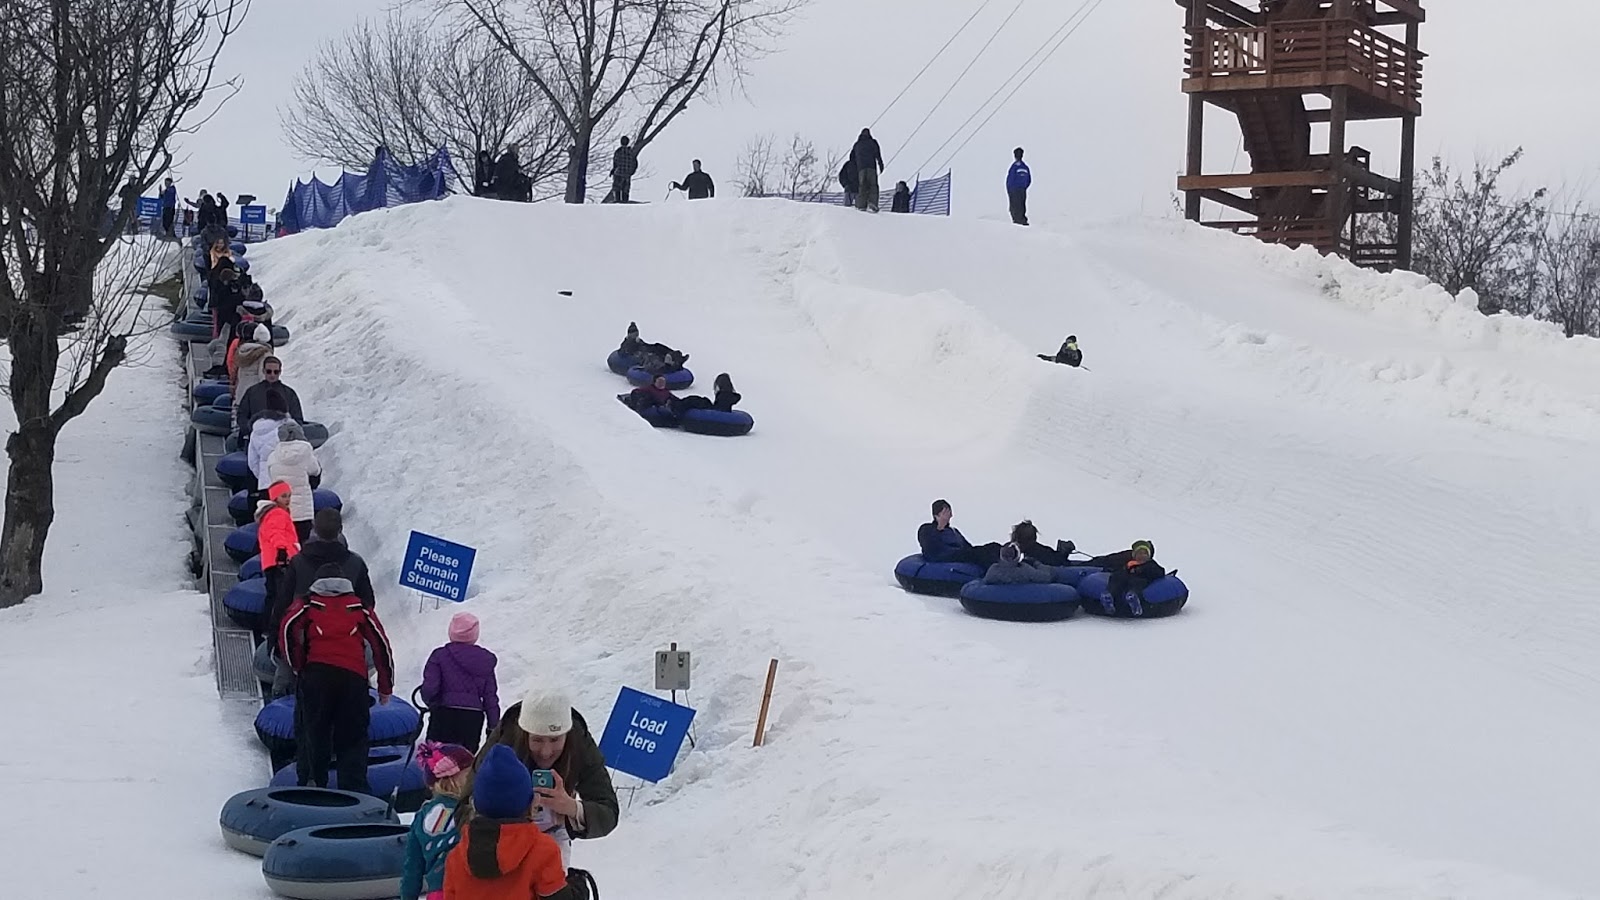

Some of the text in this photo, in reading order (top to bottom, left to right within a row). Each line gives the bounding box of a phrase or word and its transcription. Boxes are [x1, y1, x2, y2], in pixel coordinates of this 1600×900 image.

[420, 546, 459, 568] Please
[414, 559, 458, 582] Remain
[407, 571, 460, 599] Standing
[630, 710, 668, 735] Load
[624, 729, 656, 753] Here
